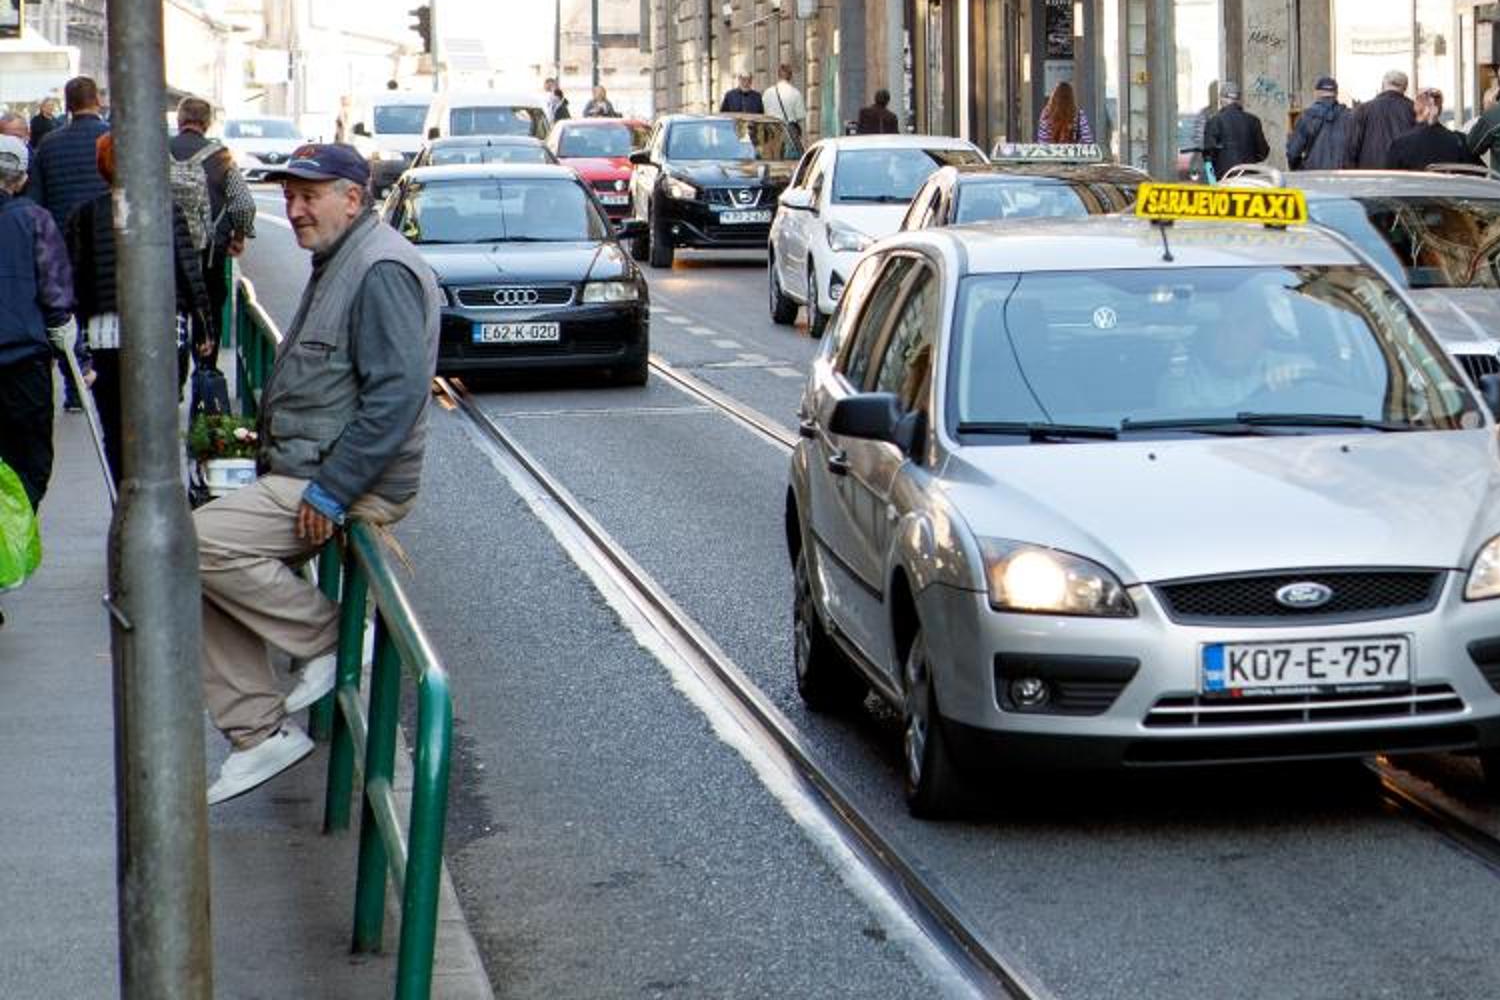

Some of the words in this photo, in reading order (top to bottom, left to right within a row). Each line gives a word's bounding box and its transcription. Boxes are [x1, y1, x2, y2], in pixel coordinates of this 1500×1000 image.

[1148, 189, 1229, 215] SARAJEVO
[1231, 193, 1295, 219] TAXI
[1230, 645, 1400, 681] K07-E-757
